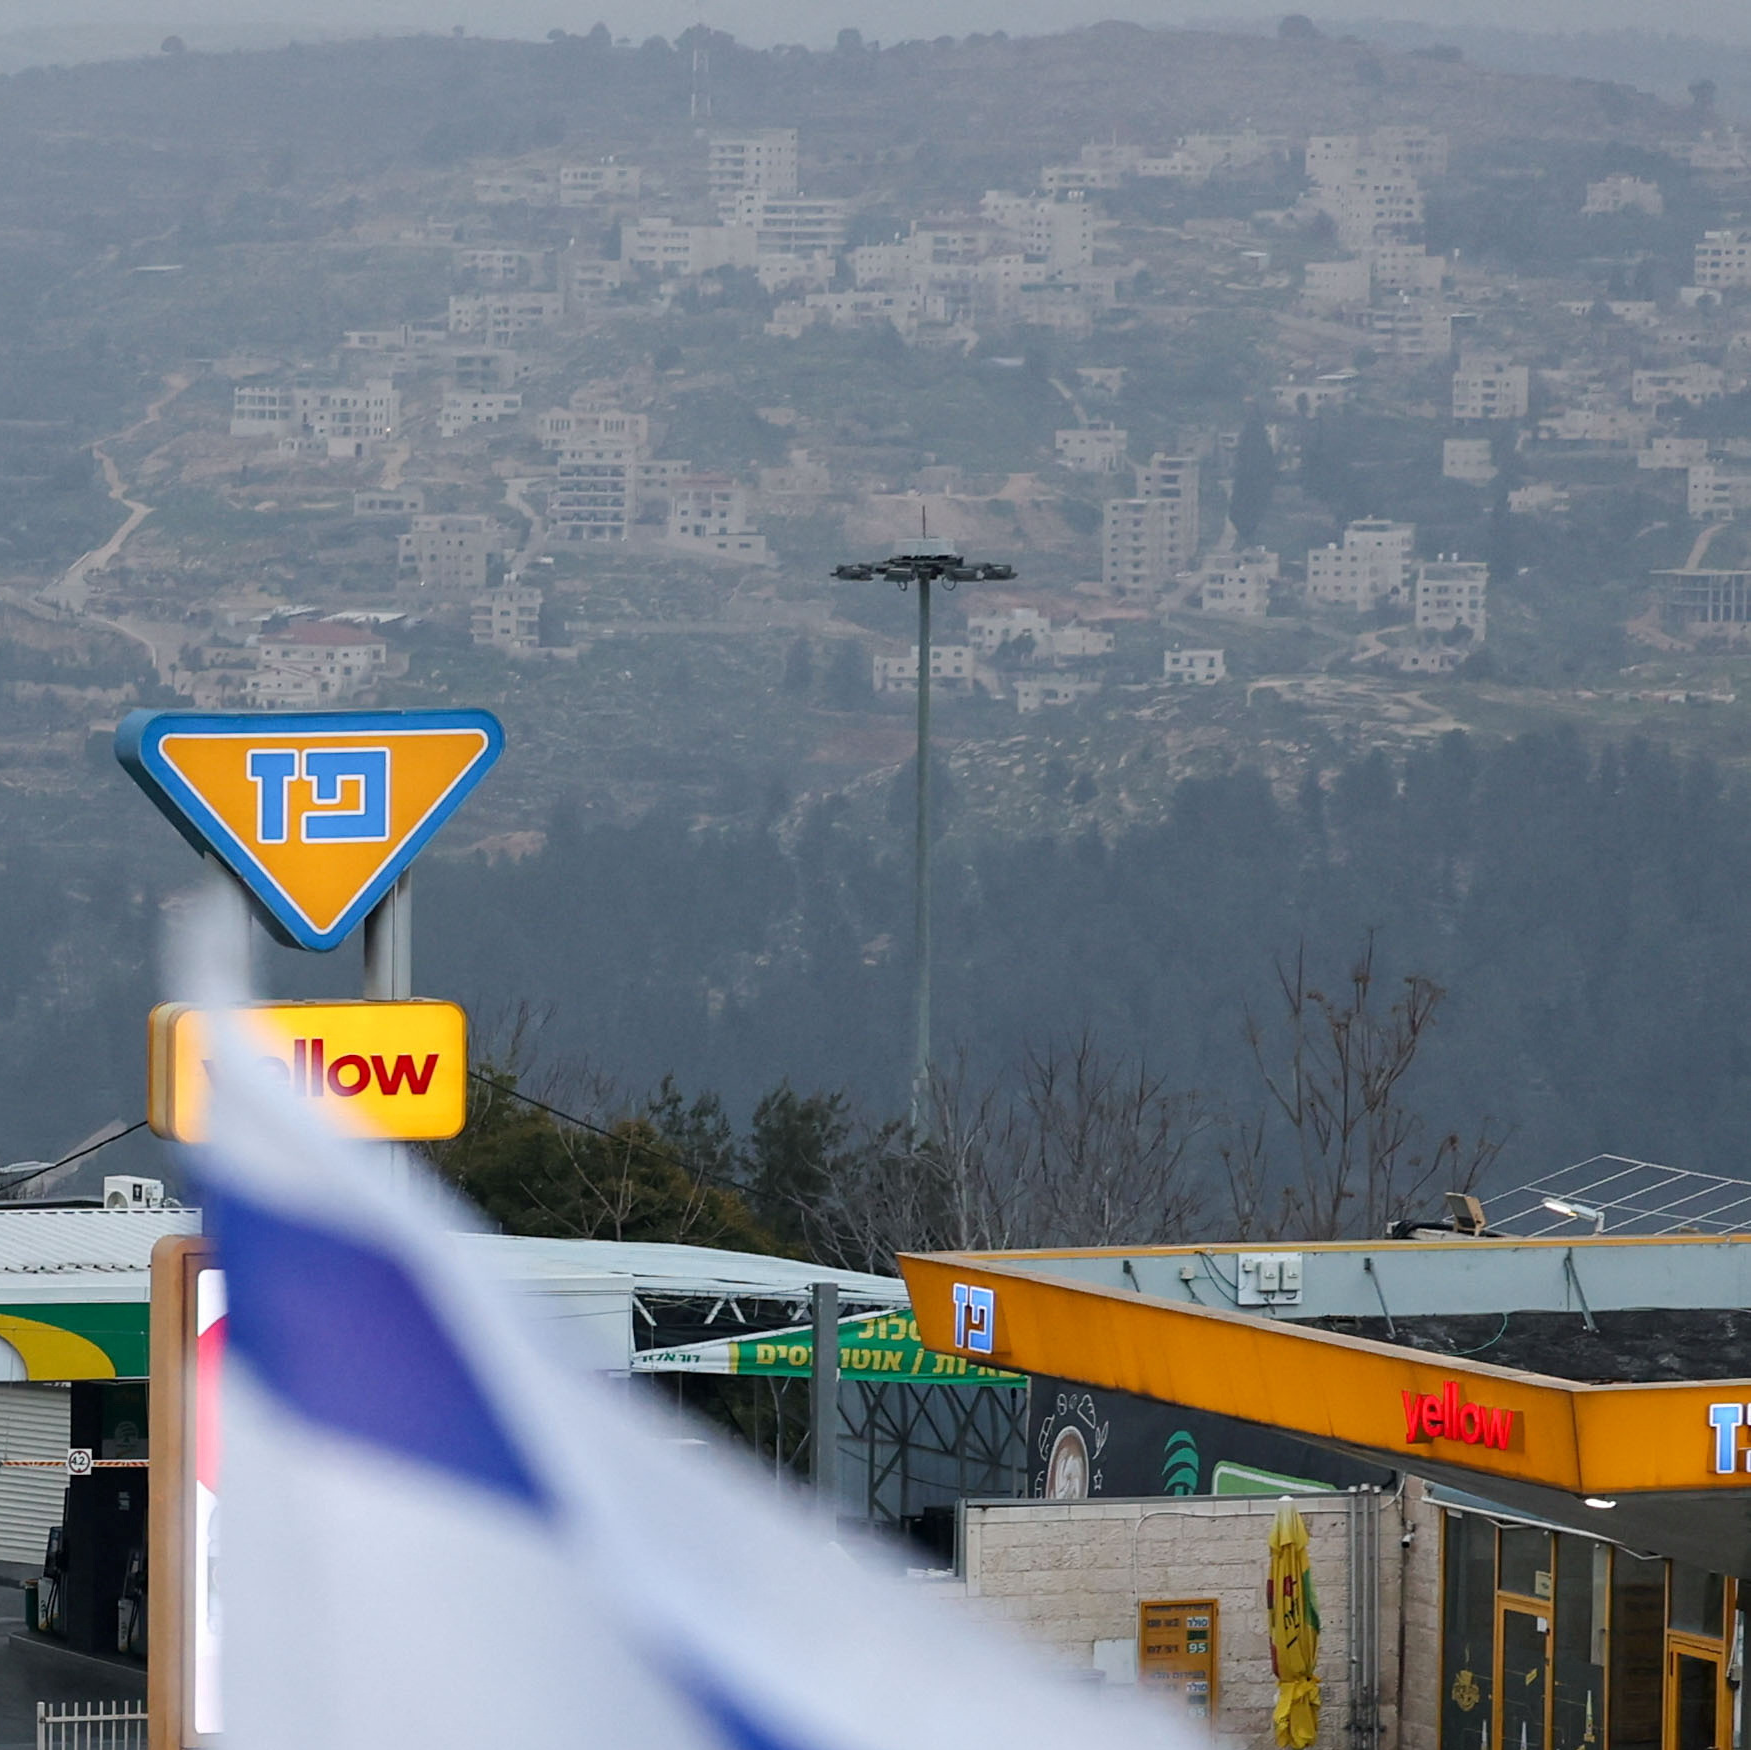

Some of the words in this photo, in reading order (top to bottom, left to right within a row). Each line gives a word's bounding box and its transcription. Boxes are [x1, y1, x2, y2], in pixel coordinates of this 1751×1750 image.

[246, 747, 390, 844] פז
[202, 1039, 438, 1097] ellow
[952, 1283, 994, 1355] פז
[1401, 1381, 1513, 1450] yellow
[1709, 1402, 1751, 1475] ז
[1189, 1643, 1207, 1653] 95
